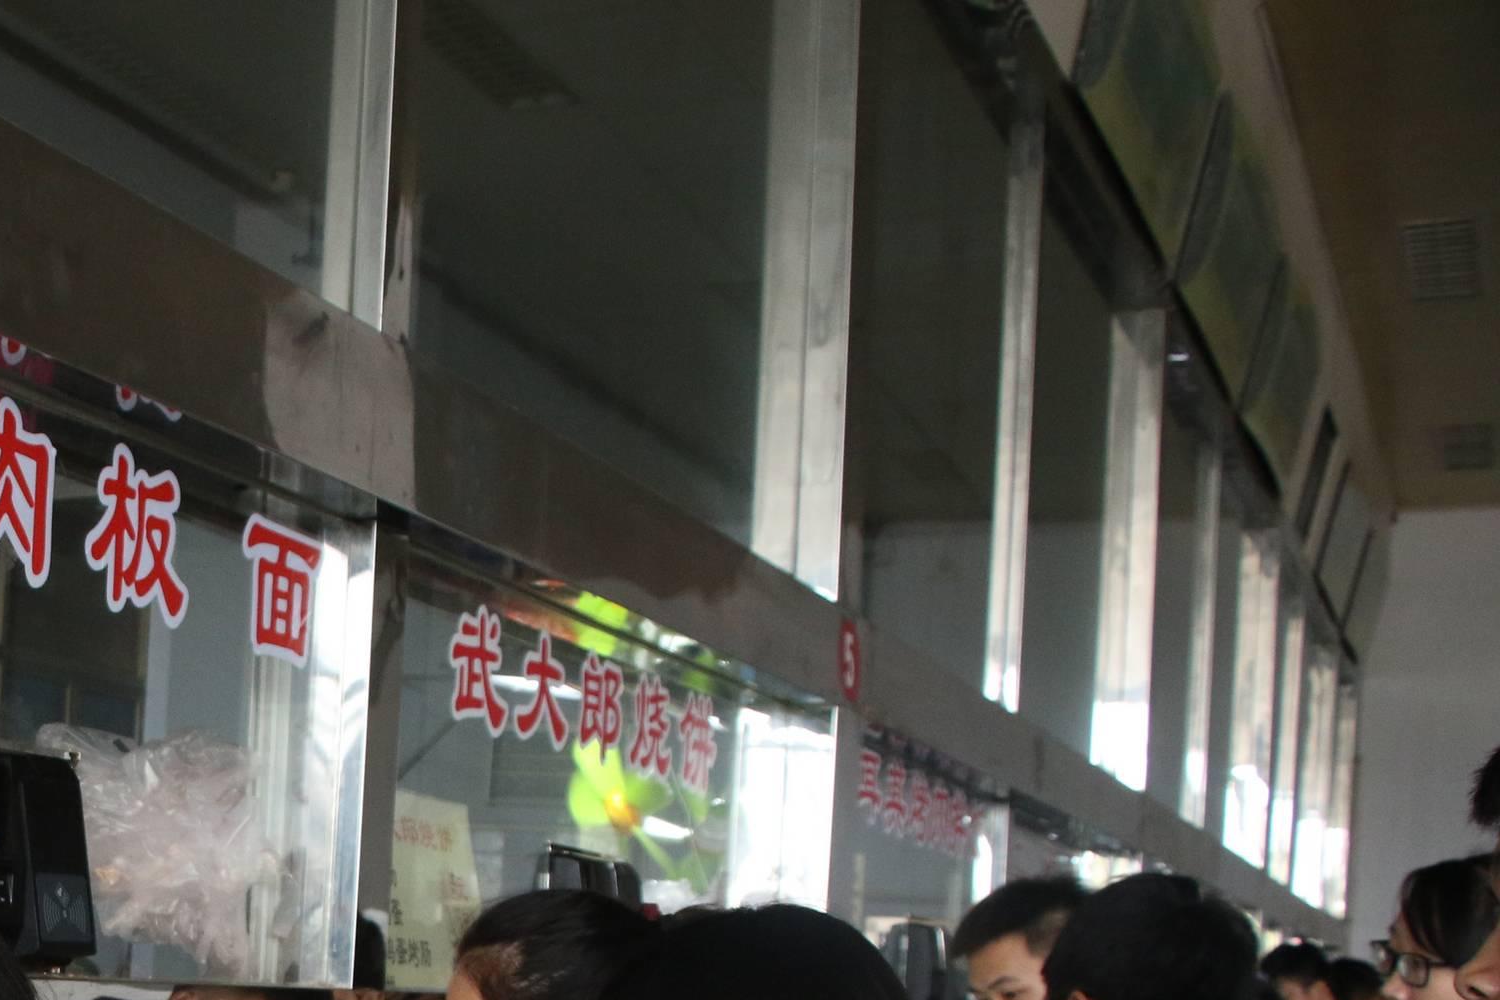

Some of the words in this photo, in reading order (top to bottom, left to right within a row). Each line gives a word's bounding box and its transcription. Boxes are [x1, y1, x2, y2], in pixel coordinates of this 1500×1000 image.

[450, 604, 718, 796] 武大郎烧饼
